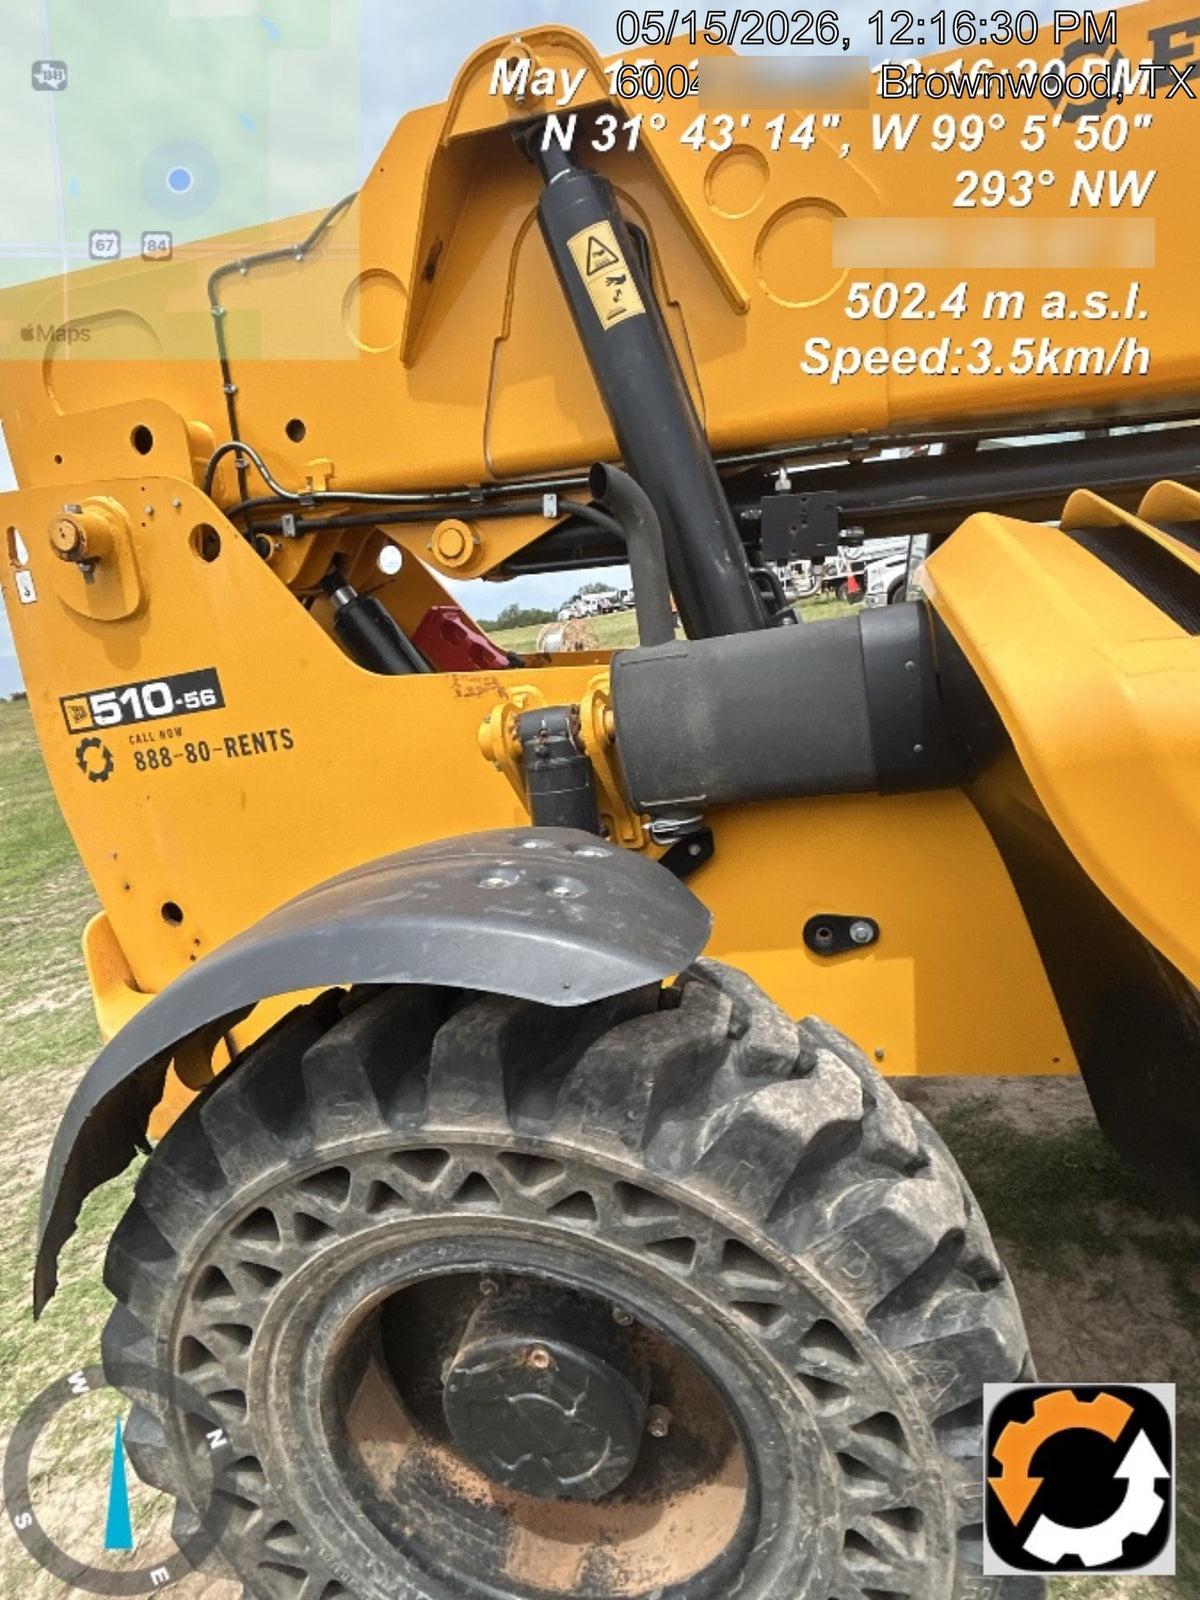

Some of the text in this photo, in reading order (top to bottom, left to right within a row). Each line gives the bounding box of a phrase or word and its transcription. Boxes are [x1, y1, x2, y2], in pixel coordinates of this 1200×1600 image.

[128, 727, 183, 745] CALL NOW
[133, 728, 295, 772] 888-80-RENTS
